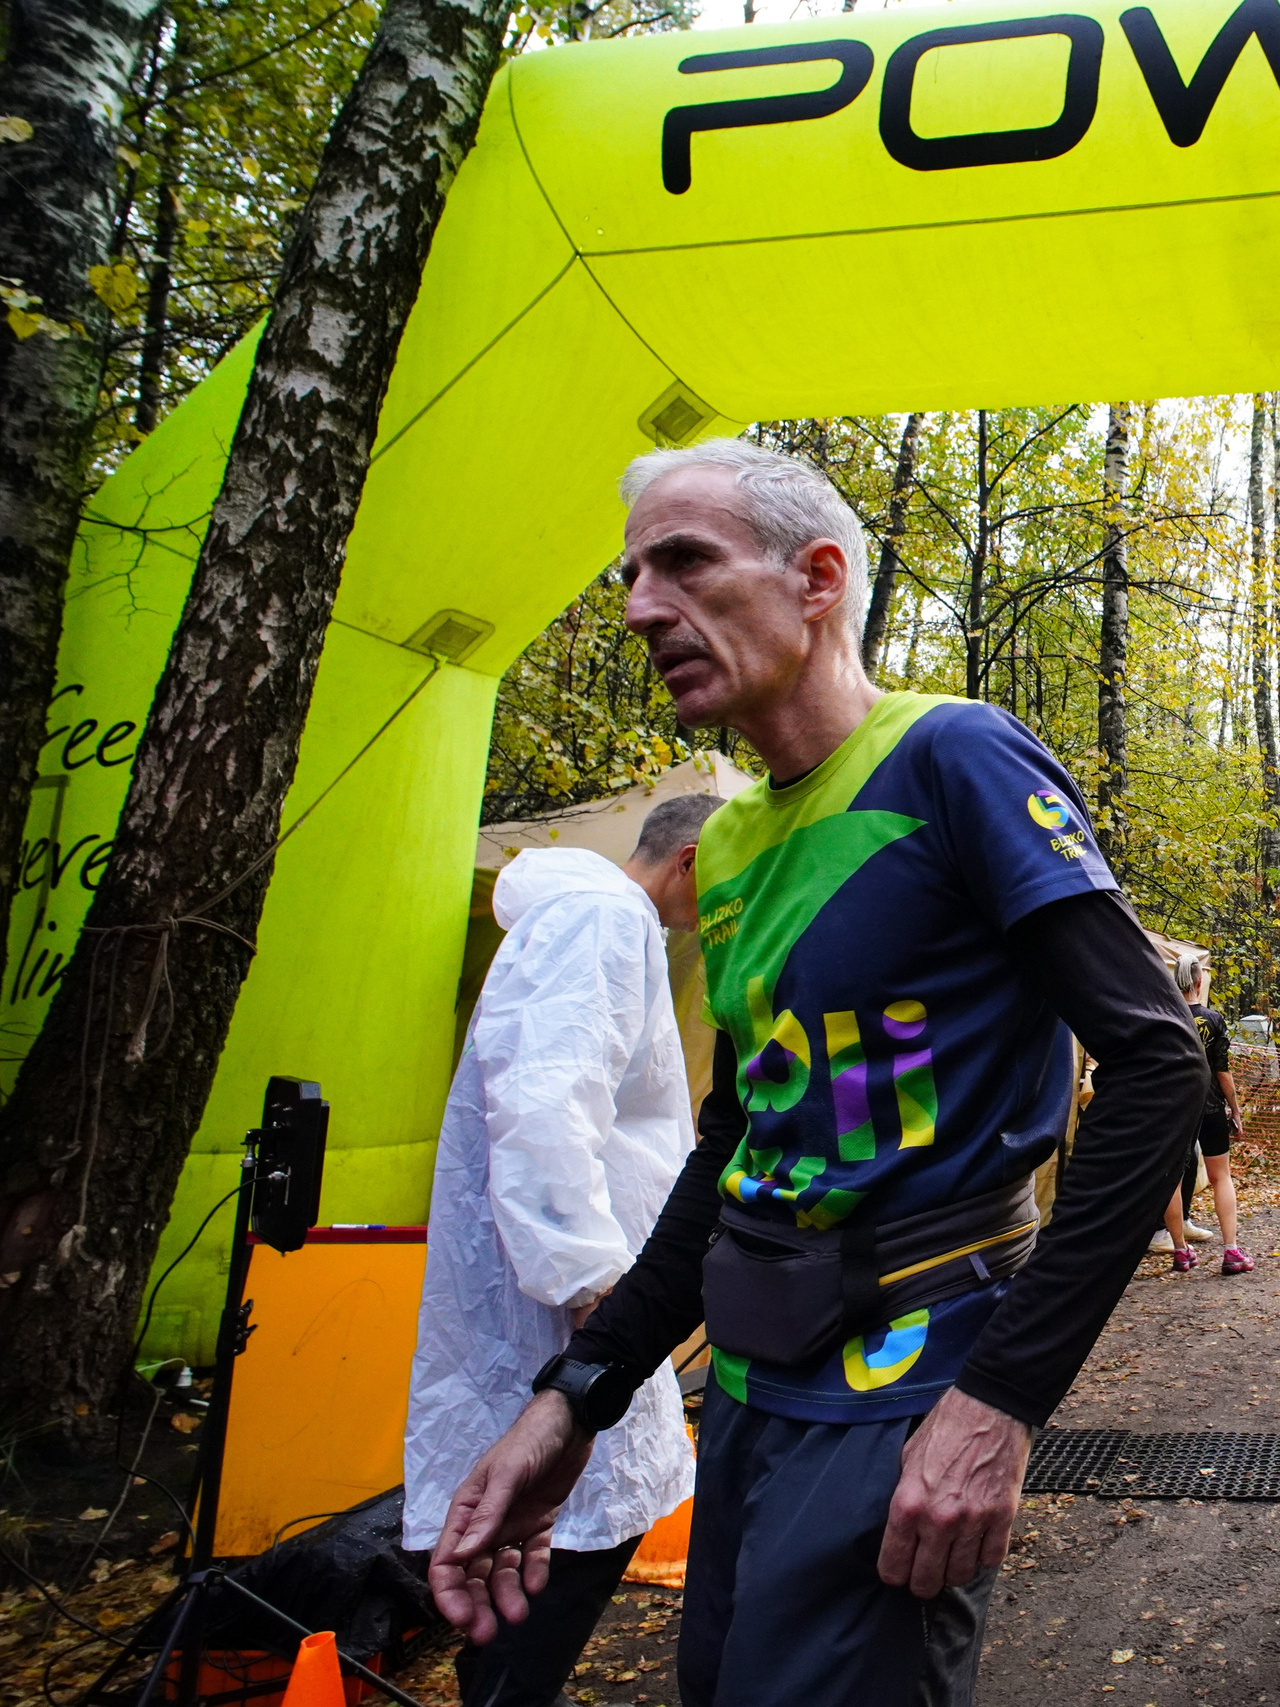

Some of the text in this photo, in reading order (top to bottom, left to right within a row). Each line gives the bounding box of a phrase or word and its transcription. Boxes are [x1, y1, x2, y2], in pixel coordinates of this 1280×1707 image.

[1050, 830, 1085, 851] BLIZKO
[700, 897, 744, 933] BLIZKO
[704, 919, 740, 949] TRAIL
